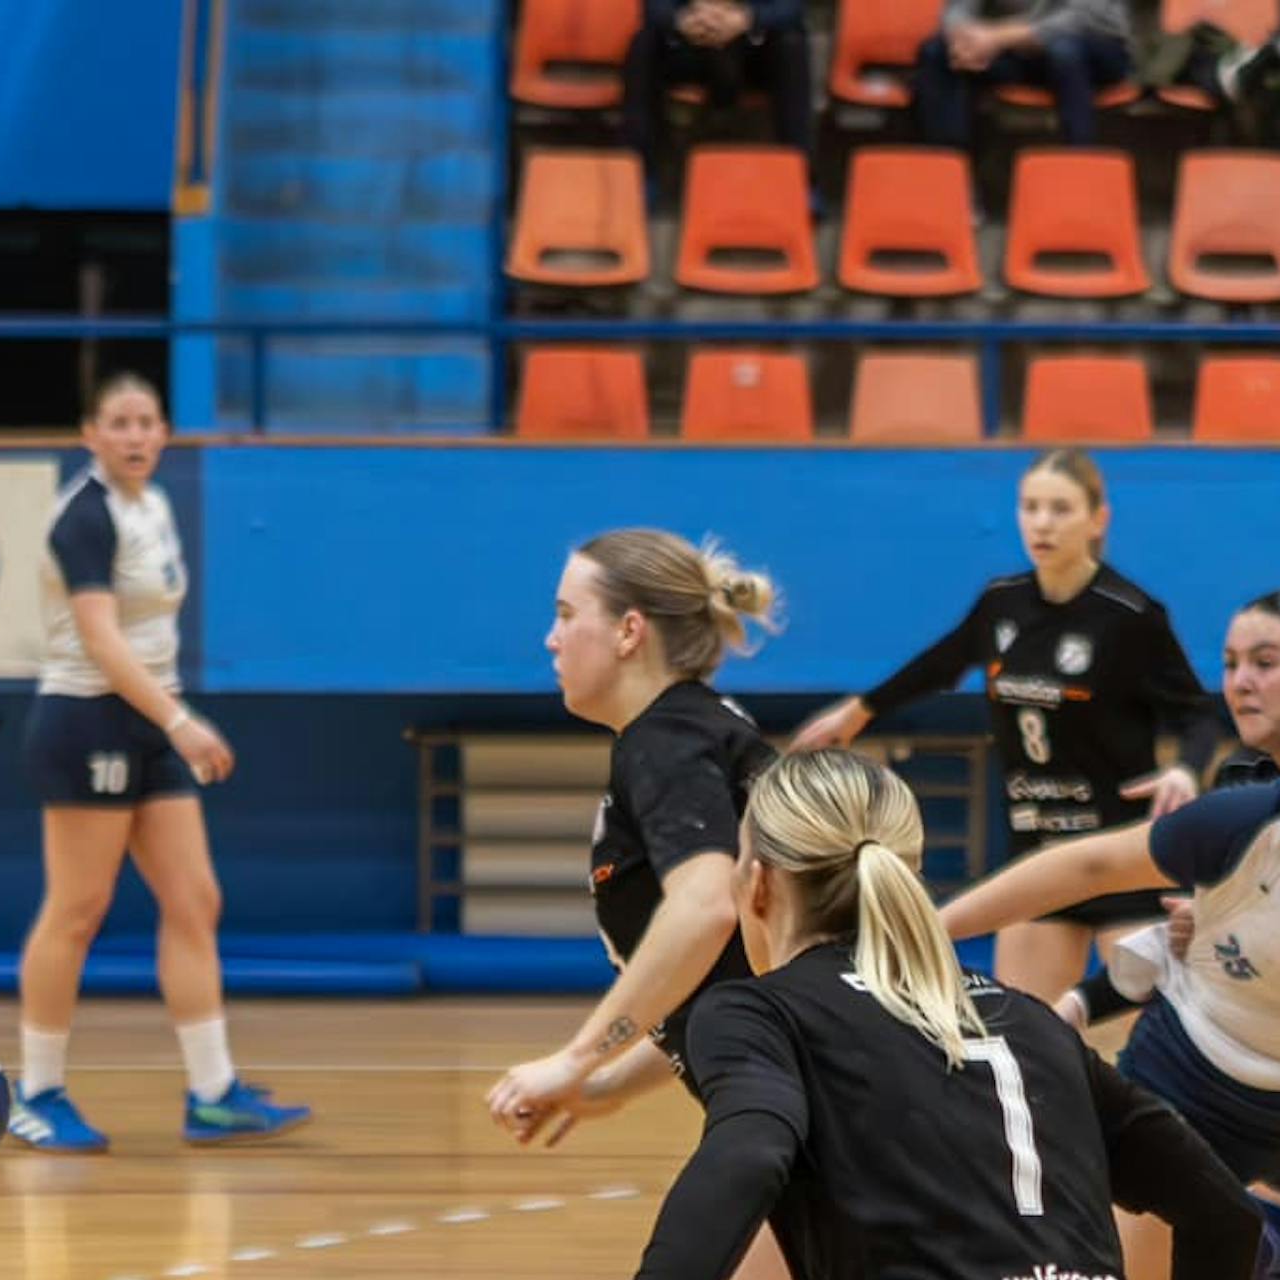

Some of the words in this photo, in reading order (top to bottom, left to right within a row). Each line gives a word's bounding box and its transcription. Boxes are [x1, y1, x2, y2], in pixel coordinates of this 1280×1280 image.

[1018, 708, 1051, 765] 8
[88, 753, 128, 794] 10
[961, 1035, 1044, 1216] 7
